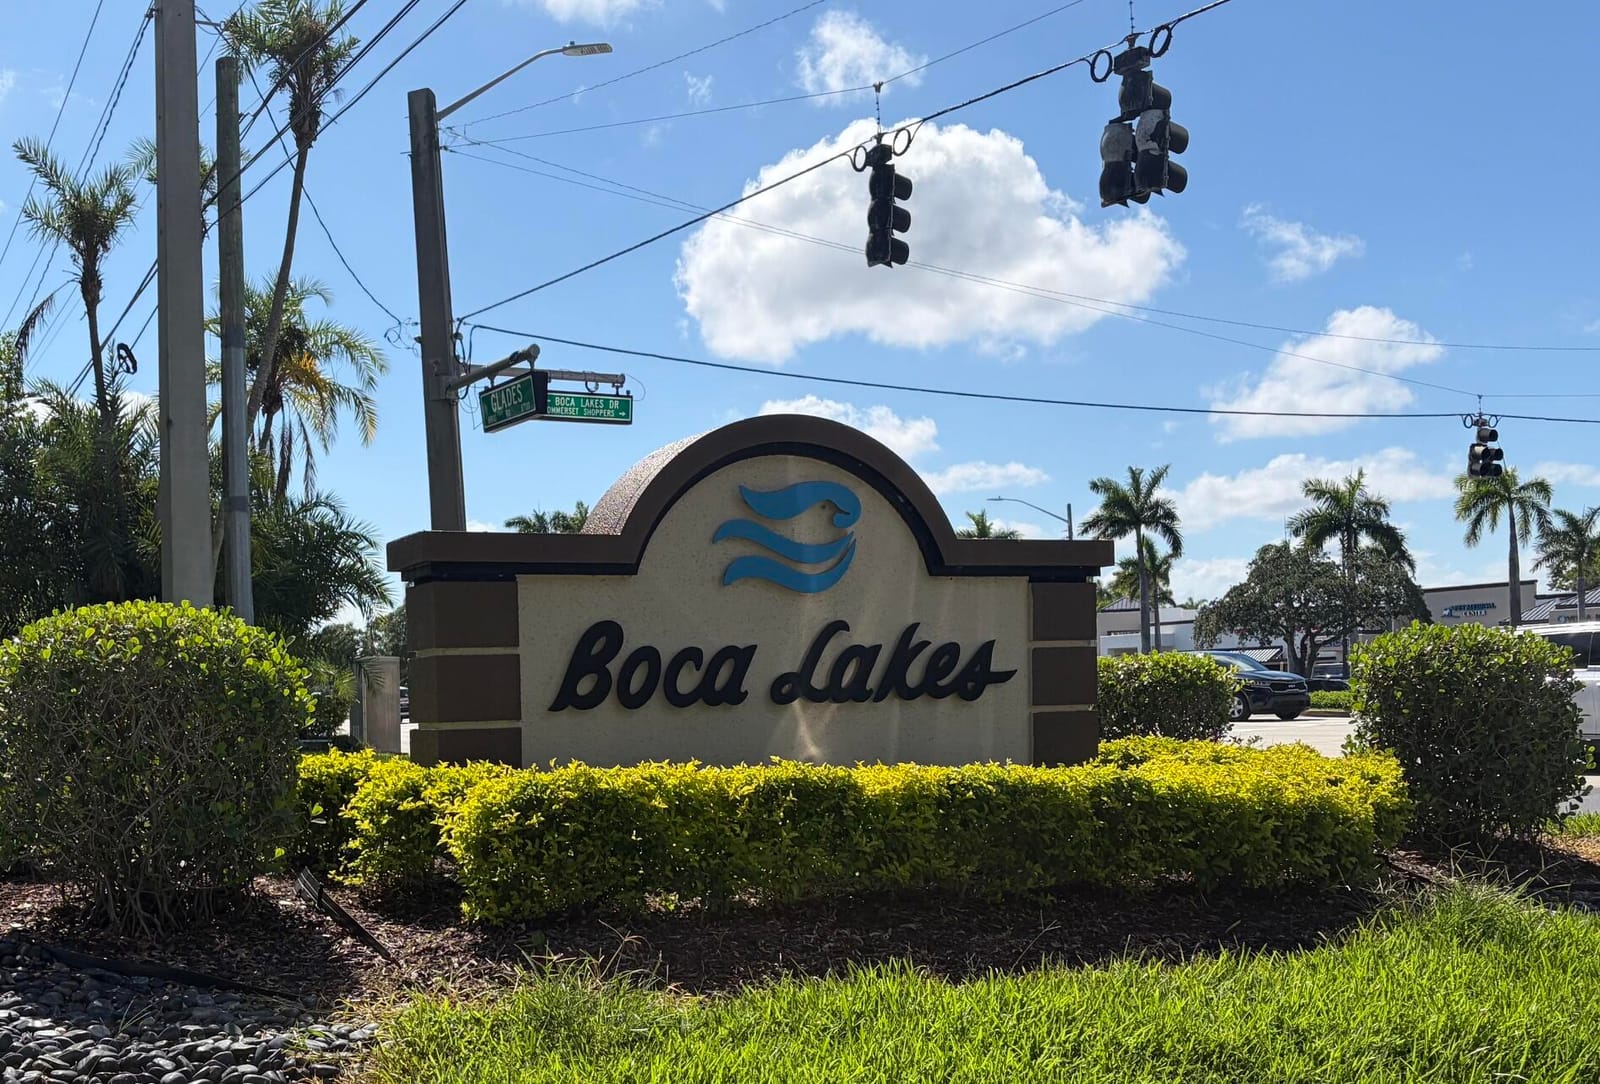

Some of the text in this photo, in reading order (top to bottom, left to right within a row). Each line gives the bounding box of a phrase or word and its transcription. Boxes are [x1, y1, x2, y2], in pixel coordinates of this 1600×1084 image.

[491, 384, 523, 413] GLADES
[555, 397, 619, 409] BOCA LAKES DR
[546, 407, 615, 417] OMMERSET SHOPPERS
[548, 619, 1018, 712] Boca Lakes
